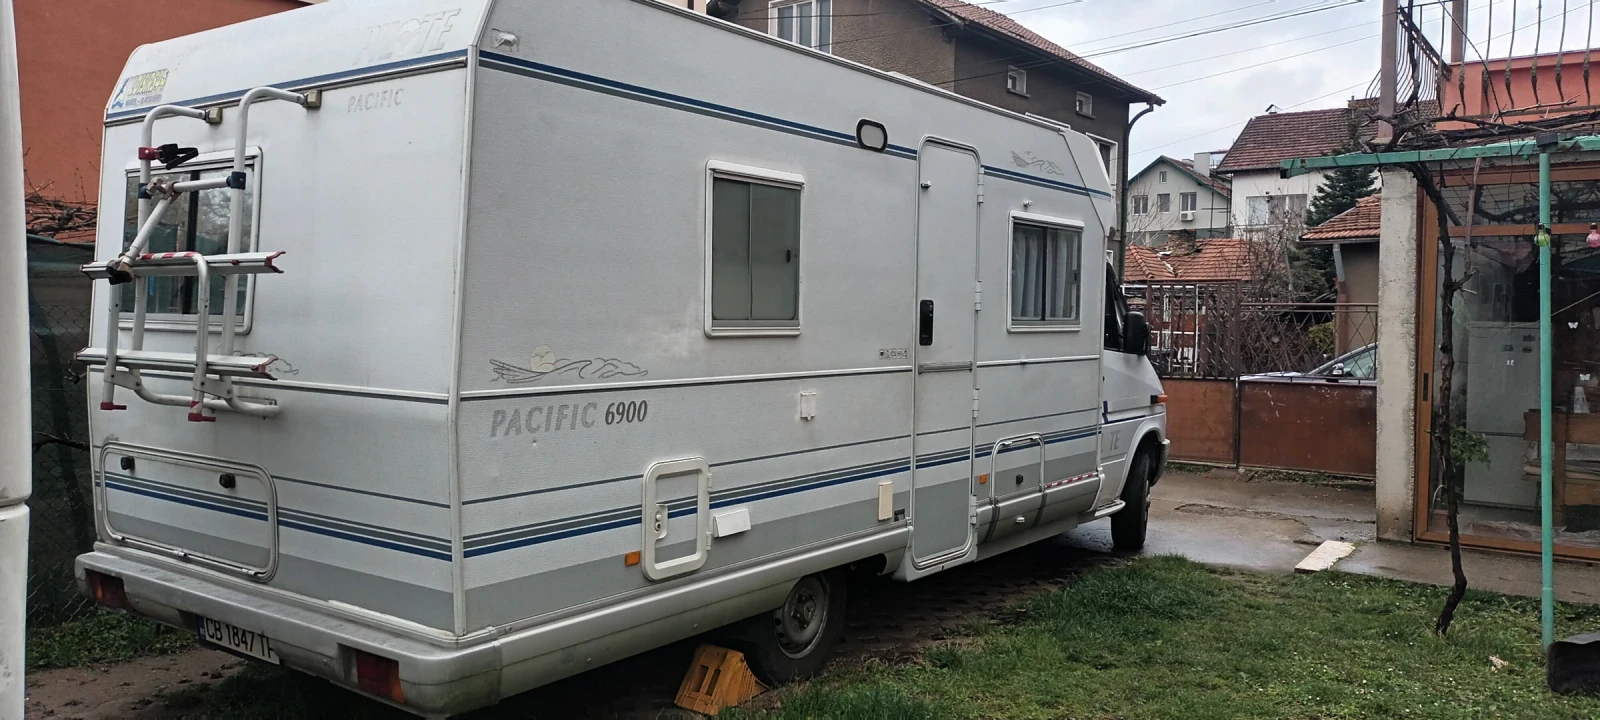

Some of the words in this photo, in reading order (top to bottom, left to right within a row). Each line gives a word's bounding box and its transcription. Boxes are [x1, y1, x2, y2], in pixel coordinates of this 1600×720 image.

[347, 88, 404, 113] PACIFIC
[489, 402, 598, 438] PACIFIC
[605, 400, 648, 425] 6900
[205, 618, 223, 642] CB
[226, 624, 255, 652] 1847
